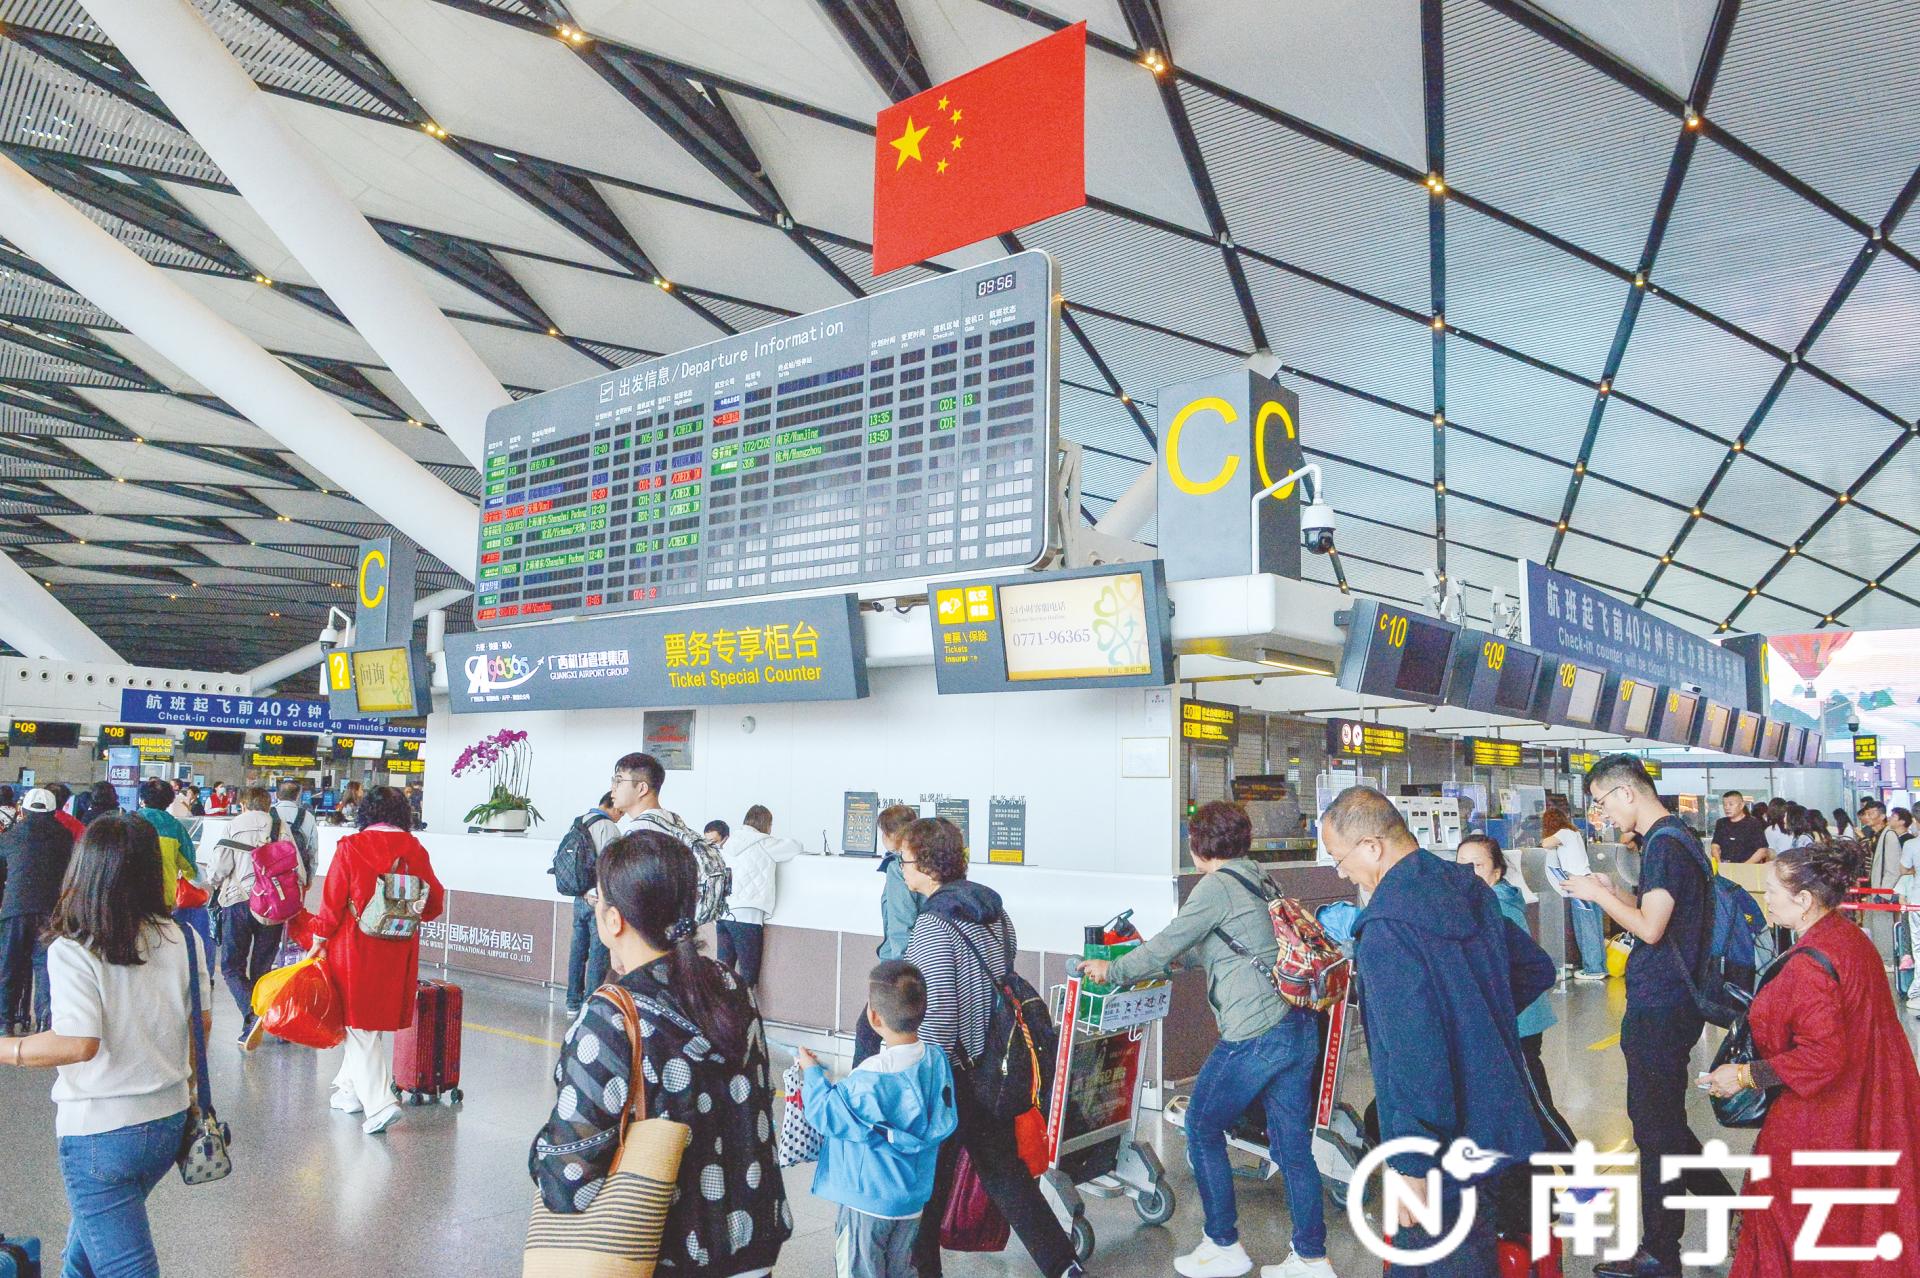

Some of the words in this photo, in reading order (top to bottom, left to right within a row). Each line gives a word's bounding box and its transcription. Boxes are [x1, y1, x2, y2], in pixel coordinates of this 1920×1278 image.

[978, 274, 1013, 296] 09:56
[754, 321, 843, 358] Information
[964, 394, 973, 406] 13
[869, 411, 890, 427] 13:35
[869, 430, 889, 444] 13:50
[1166, 396, 1240, 496] C
[1255, 401, 1296, 499] C
[359, 550, 385, 608] C
[1013, 628, 1091, 647] 0771-96365
[1379, 613, 1408, 648] C10
[1558, 627, 1594, 655] Check-in
[663, 620, 819, 668] 票务专享柜台
[1484, 641, 1505, 671] C09
[548, 650, 629, 670] 广西机场管理集团
[578, 669, 605, 679] AIRPORT
[607, 668, 629, 677] GROUP
[669, 670, 707, 689] Ticket
[711, 667, 760, 688] Special
[764, 665, 822, 683] Counter
[146, 693, 378, 722] 航班起飞前40分钟
[158, 711, 205, 722] Check-in
[210, 715, 250, 725] counter
[254, 718, 272, 726] will
[276, 718, 288, 727] be
[292, 718, 324, 729] closed
[331, 721, 342, 729] 40
[348, 723, 384, 732] minutes
[388, 726, 416, 734] before
[447, 944, 486, 956] INTERNATIONAL
